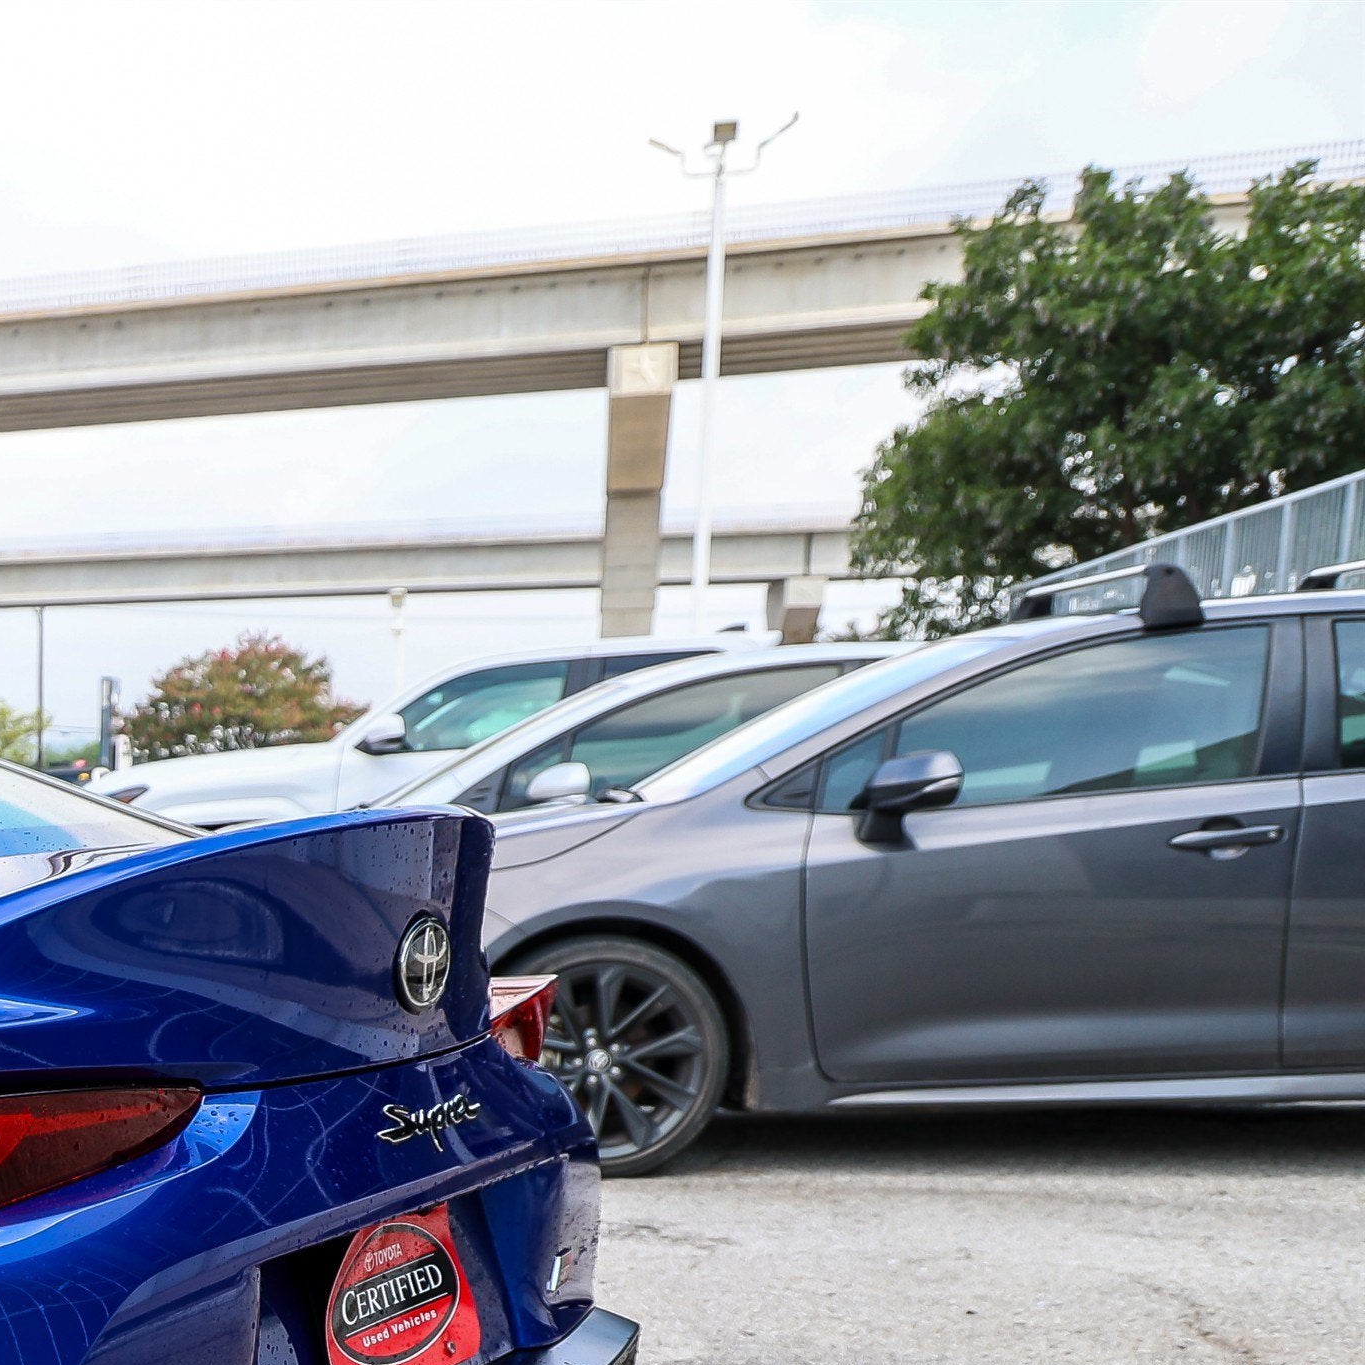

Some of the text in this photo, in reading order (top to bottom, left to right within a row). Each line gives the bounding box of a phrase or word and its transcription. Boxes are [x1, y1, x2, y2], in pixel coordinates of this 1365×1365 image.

[374, 1093, 481, 1152] Supra
[373, 1243, 403, 1266] TOYOTA
[341, 1264, 443, 1325] CERTIFIED
[362, 1309, 437, 1348] Used Vehicles
